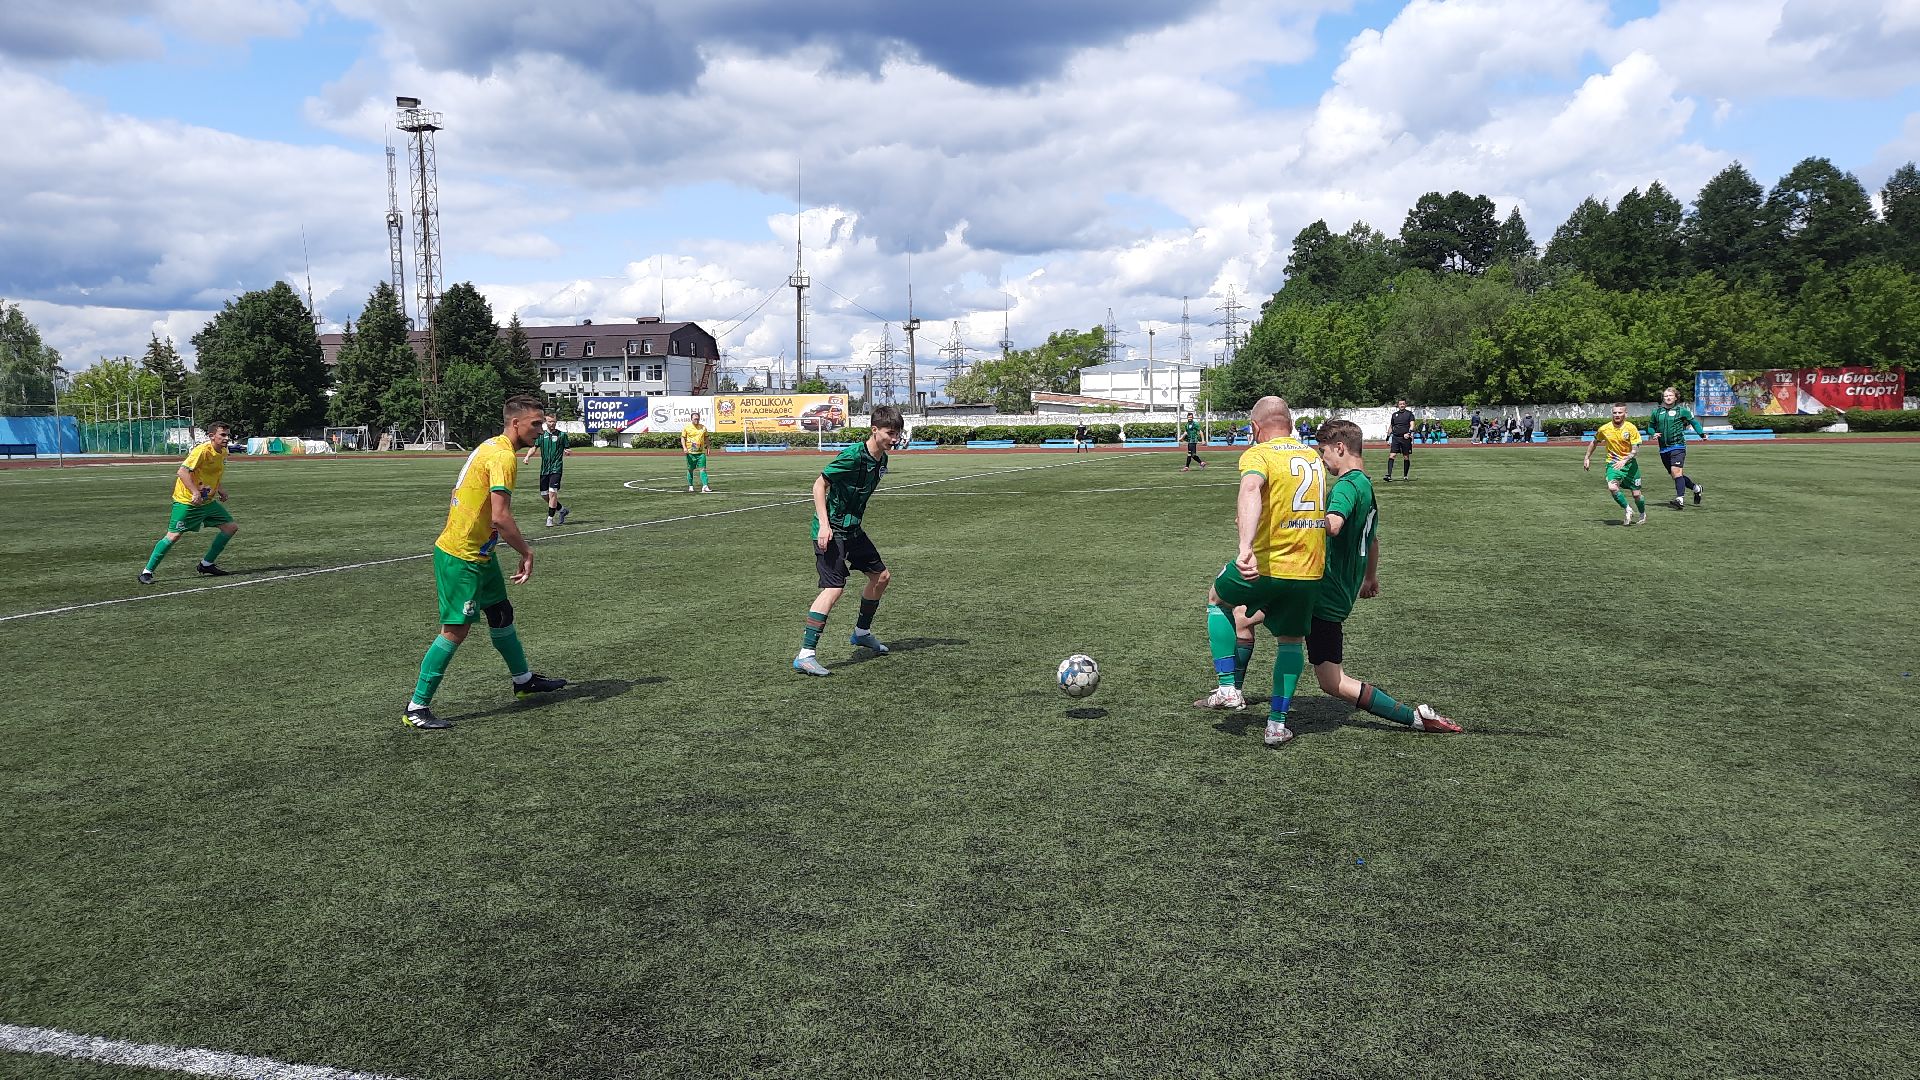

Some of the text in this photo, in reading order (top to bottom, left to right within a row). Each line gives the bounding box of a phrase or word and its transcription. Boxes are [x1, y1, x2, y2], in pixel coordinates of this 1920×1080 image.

[1775, 372, 1793, 383] 112
[1804, 372, 1898, 385] Я выбираю
[1845, 384, 1899, 397] спорт!
[587, 400, 623, 411] Спорт
[740, 398, 794, 407] АВТОШКОЛА
[587, 411, 625, 421] норма
[673, 407, 709, 416] ГРАНИТ
[588, 420, 629, 429] жизни!
[1289, 456, 1325, 512] 21
